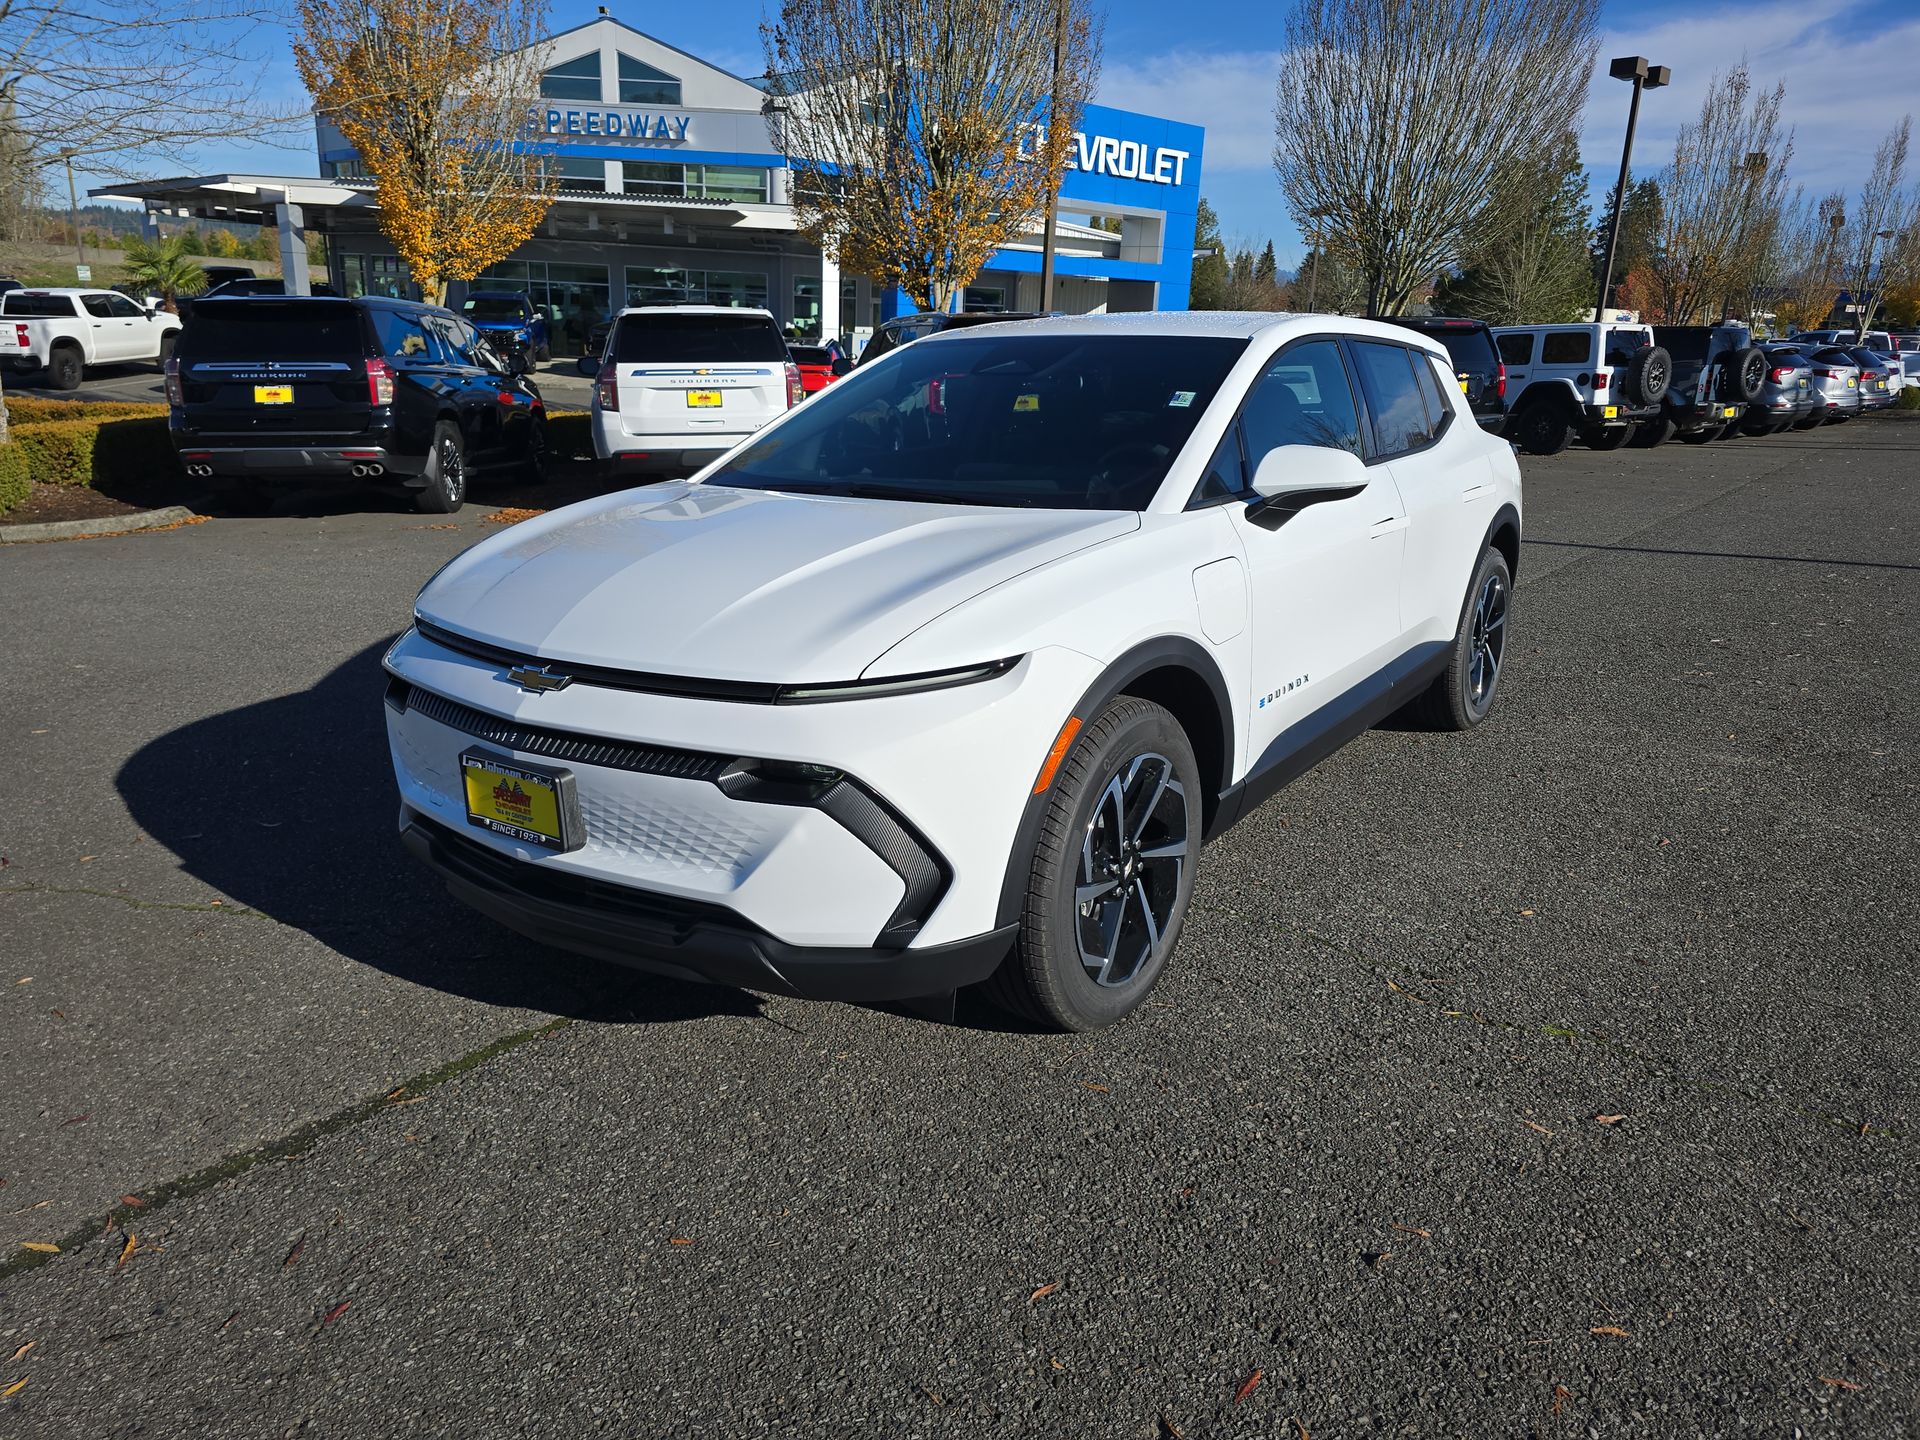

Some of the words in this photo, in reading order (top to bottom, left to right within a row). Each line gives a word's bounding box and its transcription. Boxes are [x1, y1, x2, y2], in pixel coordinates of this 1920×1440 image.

[527, 108, 690, 140] SPEEDWAY
[1015, 121, 1190, 186] CEVROLET
[1259, 673, 1310, 709] EQUINOX
[491, 822, 517, 836] SINCE
